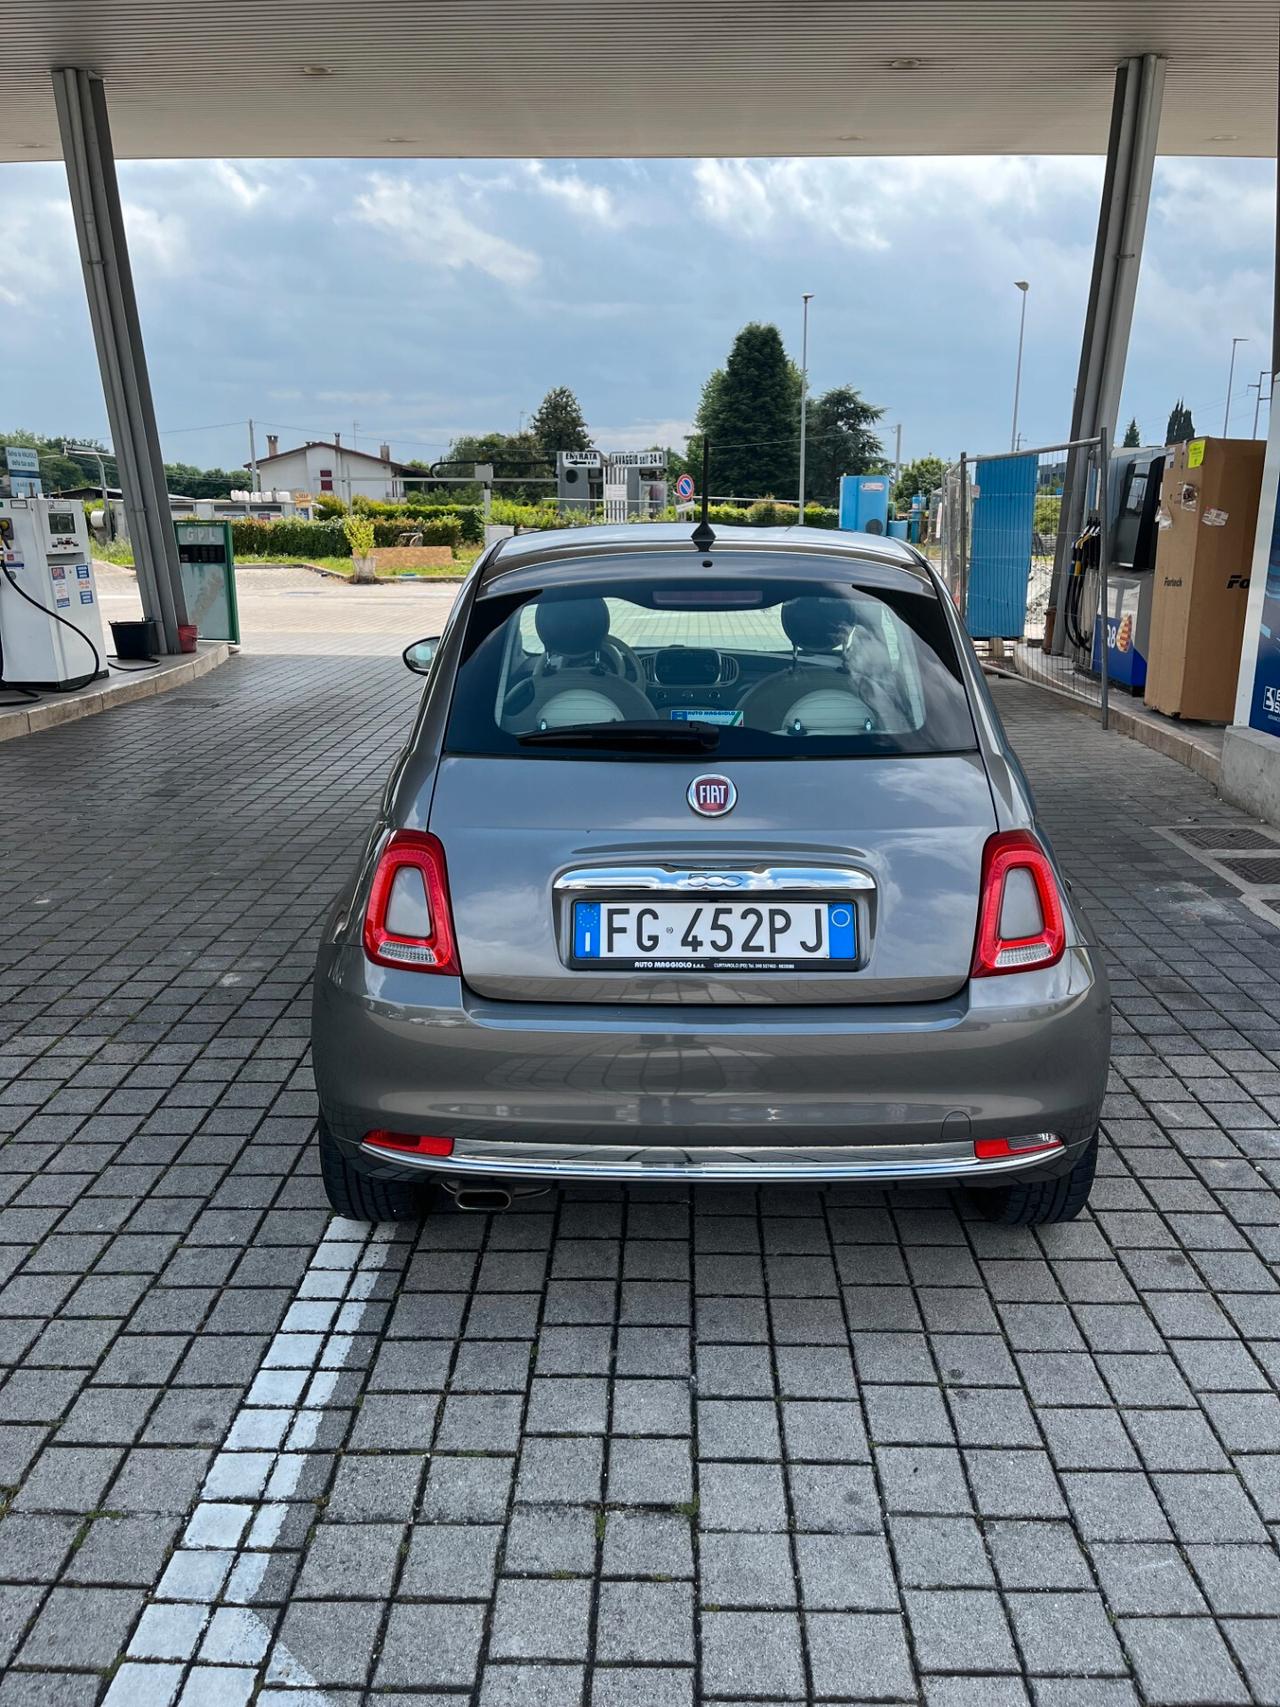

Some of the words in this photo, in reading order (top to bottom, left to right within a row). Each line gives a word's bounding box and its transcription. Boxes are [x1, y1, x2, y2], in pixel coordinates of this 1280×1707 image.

[565, 452, 597, 460] ENTRATA
[649, 453, 657, 465] 24
[186, 527, 217, 542] GPL
[1164, 576, 1182, 587] Fortech
[700, 785, 726, 804] FIAT
[687, 872, 743, 888] 500
[606, 907, 660, 953] FG
